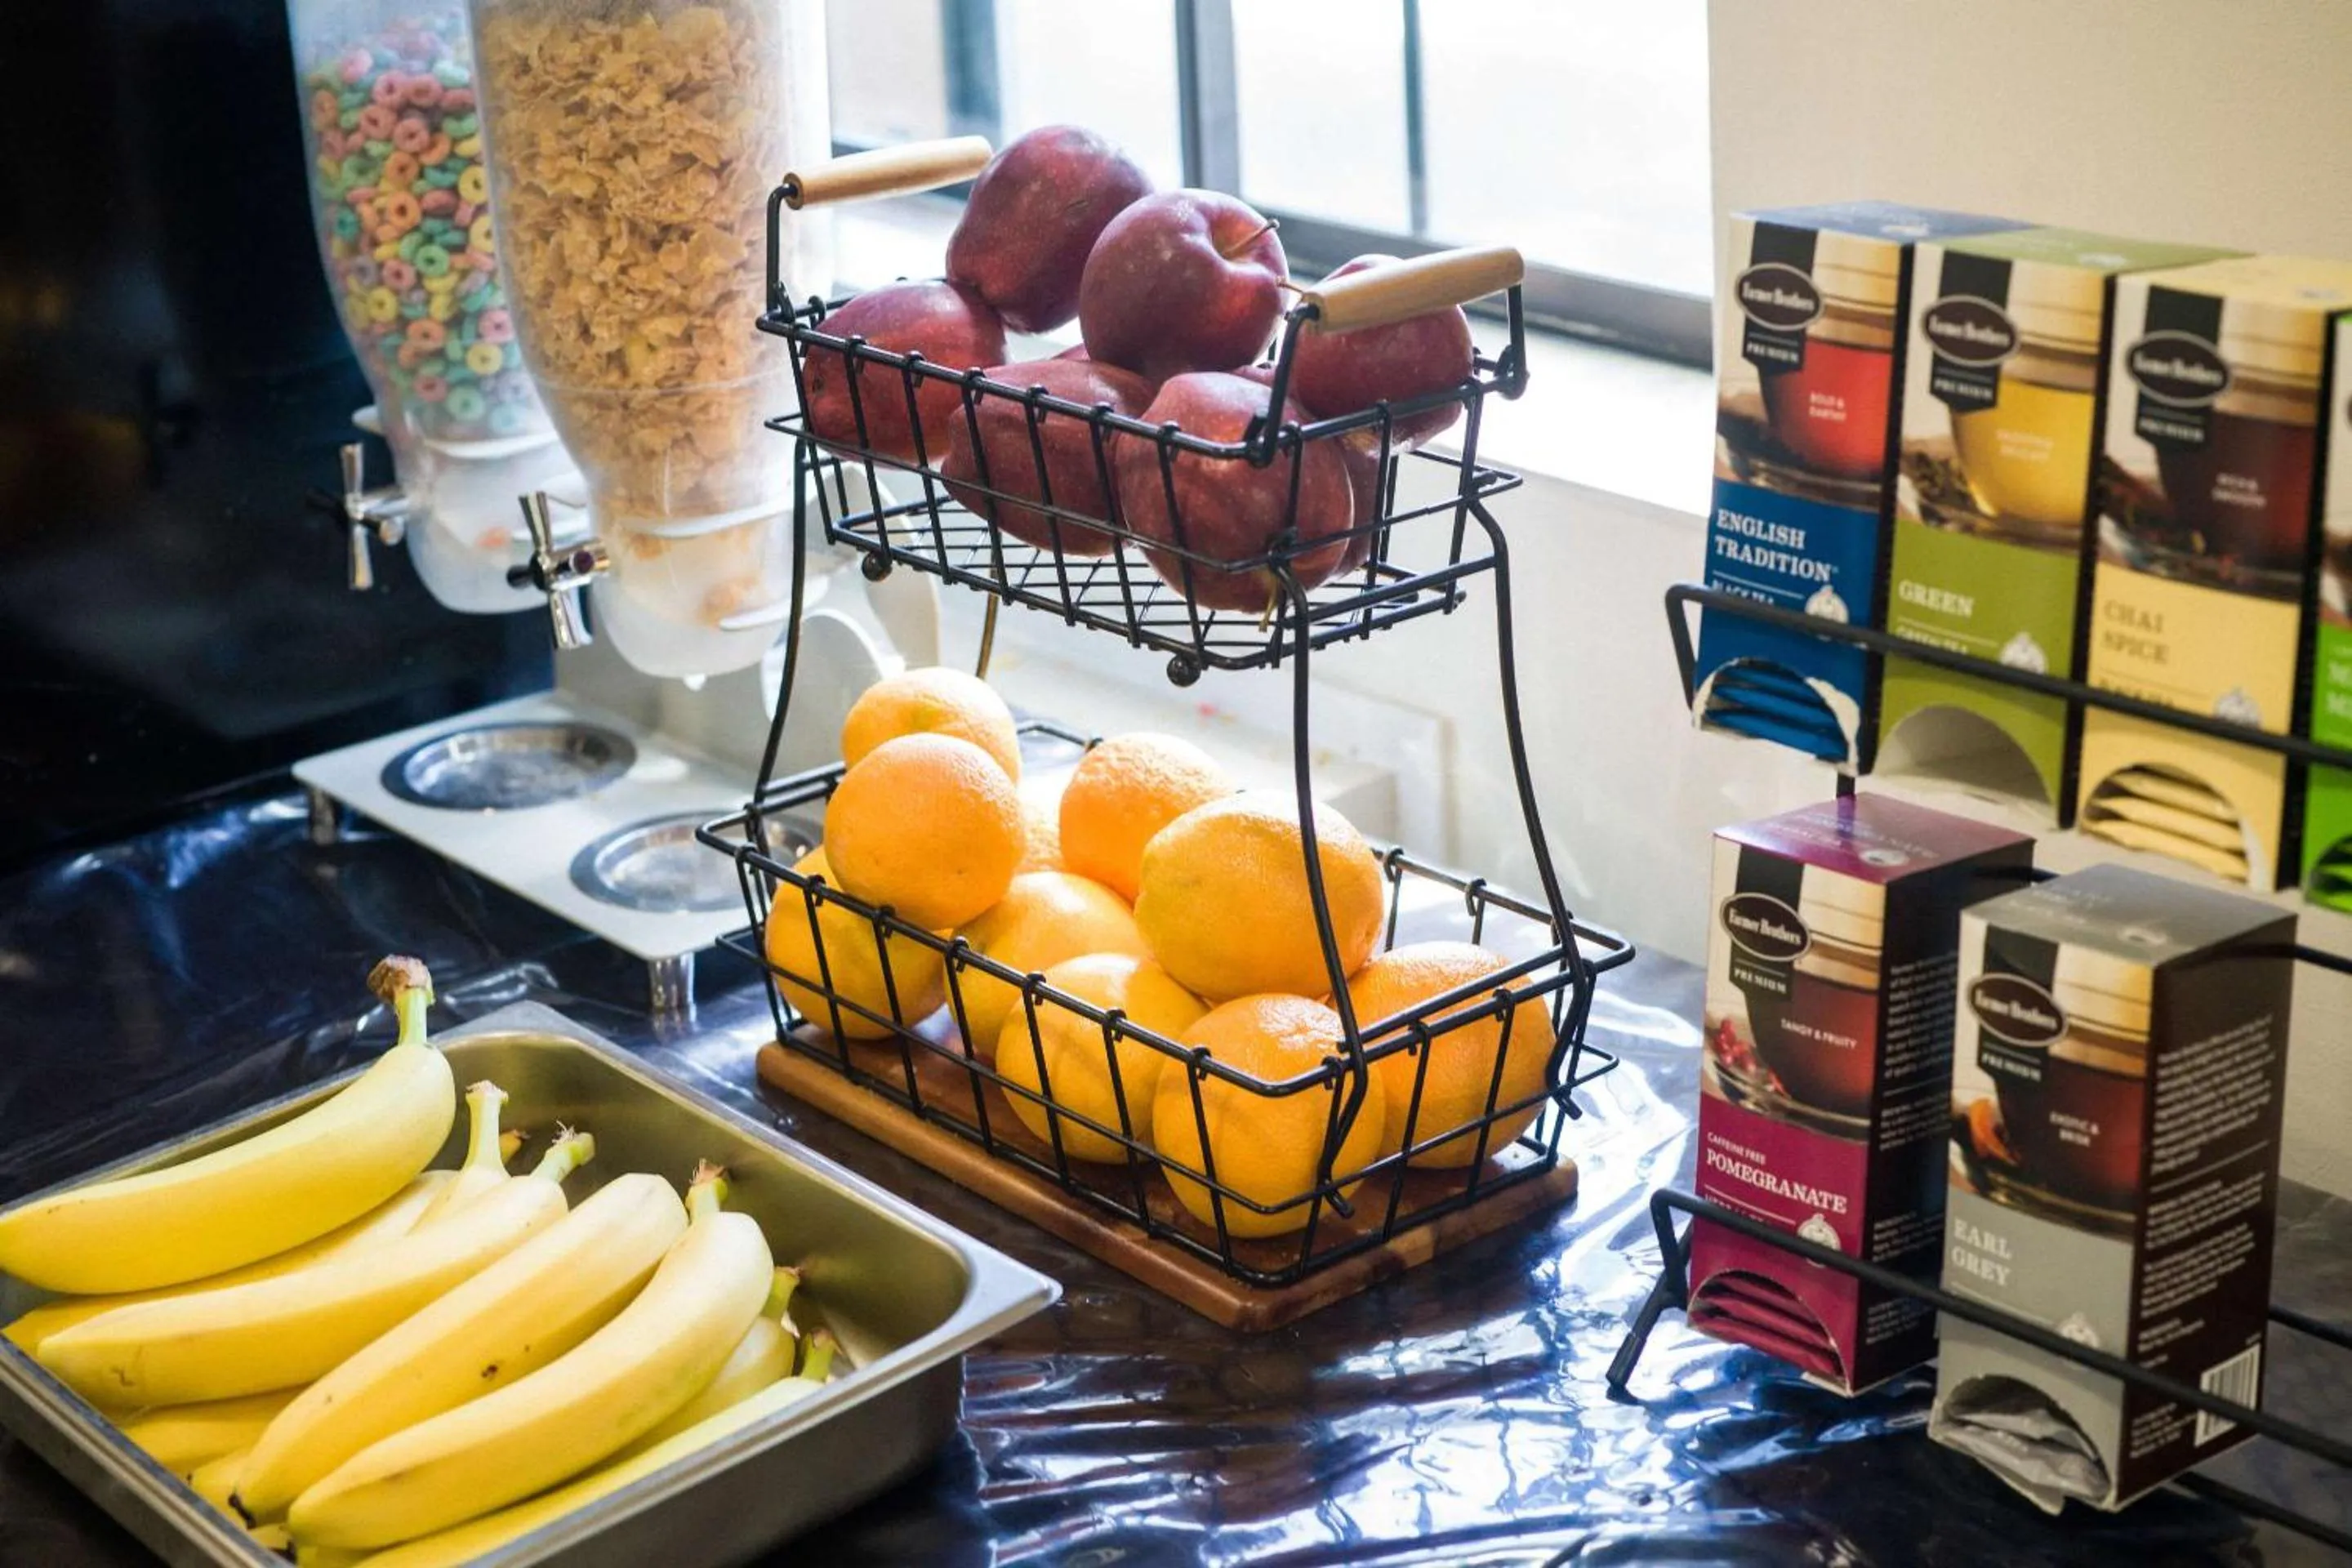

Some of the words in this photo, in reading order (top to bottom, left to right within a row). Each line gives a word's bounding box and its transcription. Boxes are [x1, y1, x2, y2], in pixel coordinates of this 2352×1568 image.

[1716, 508, 1806, 550] ENGLISH
[1898, 578, 1976, 618] GREEN
[2103, 599, 2164, 635] CHAI
[2101, 630, 2170, 665] SPICE
[1733, 967, 1787, 994] PREMIUM
[1707, 1131, 1745, 1158] CAFFEINE
[1744, 1147, 1766, 1165] FREE
[1706, 1147, 1848, 1214] POMEGRANATE
[1953, 1218, 2012, 1261] EARL
[1951, 1245, 2011, 1286] GREY
